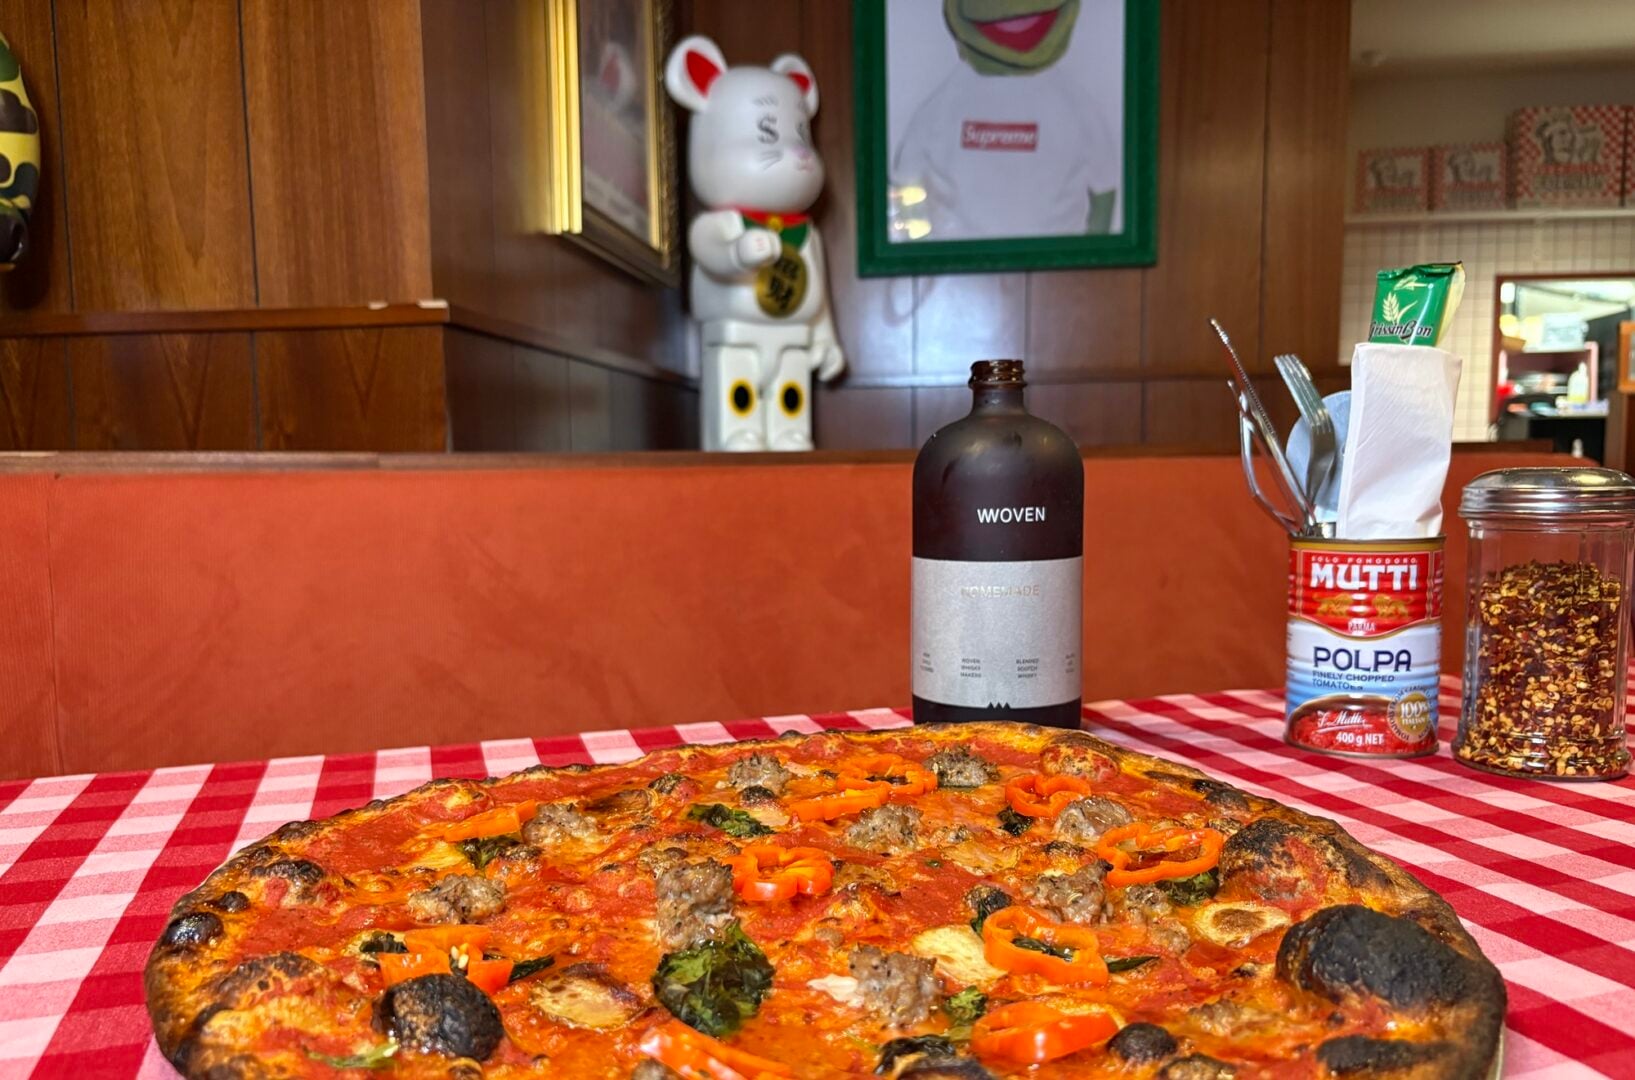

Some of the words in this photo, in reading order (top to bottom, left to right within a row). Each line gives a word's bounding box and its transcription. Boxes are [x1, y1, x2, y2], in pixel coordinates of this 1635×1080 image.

[966, 124, 1035, 148] Supreme
[1348, 557, 1417, 565] POMODORO
[1310, 563, 1417, 591] MUTTI
[1313, 646, 1411, 672] POLPA
[1312, 670, 1343, 680] FINELY
[1346, 673, 1395, 682] CHOPPED
[1401, 701, 1428, 718] 100%
[1336, 732, 1354, 743] 400
[1355, 735, 1363, 745] g
[1365, 733, 1384, 745] NET
